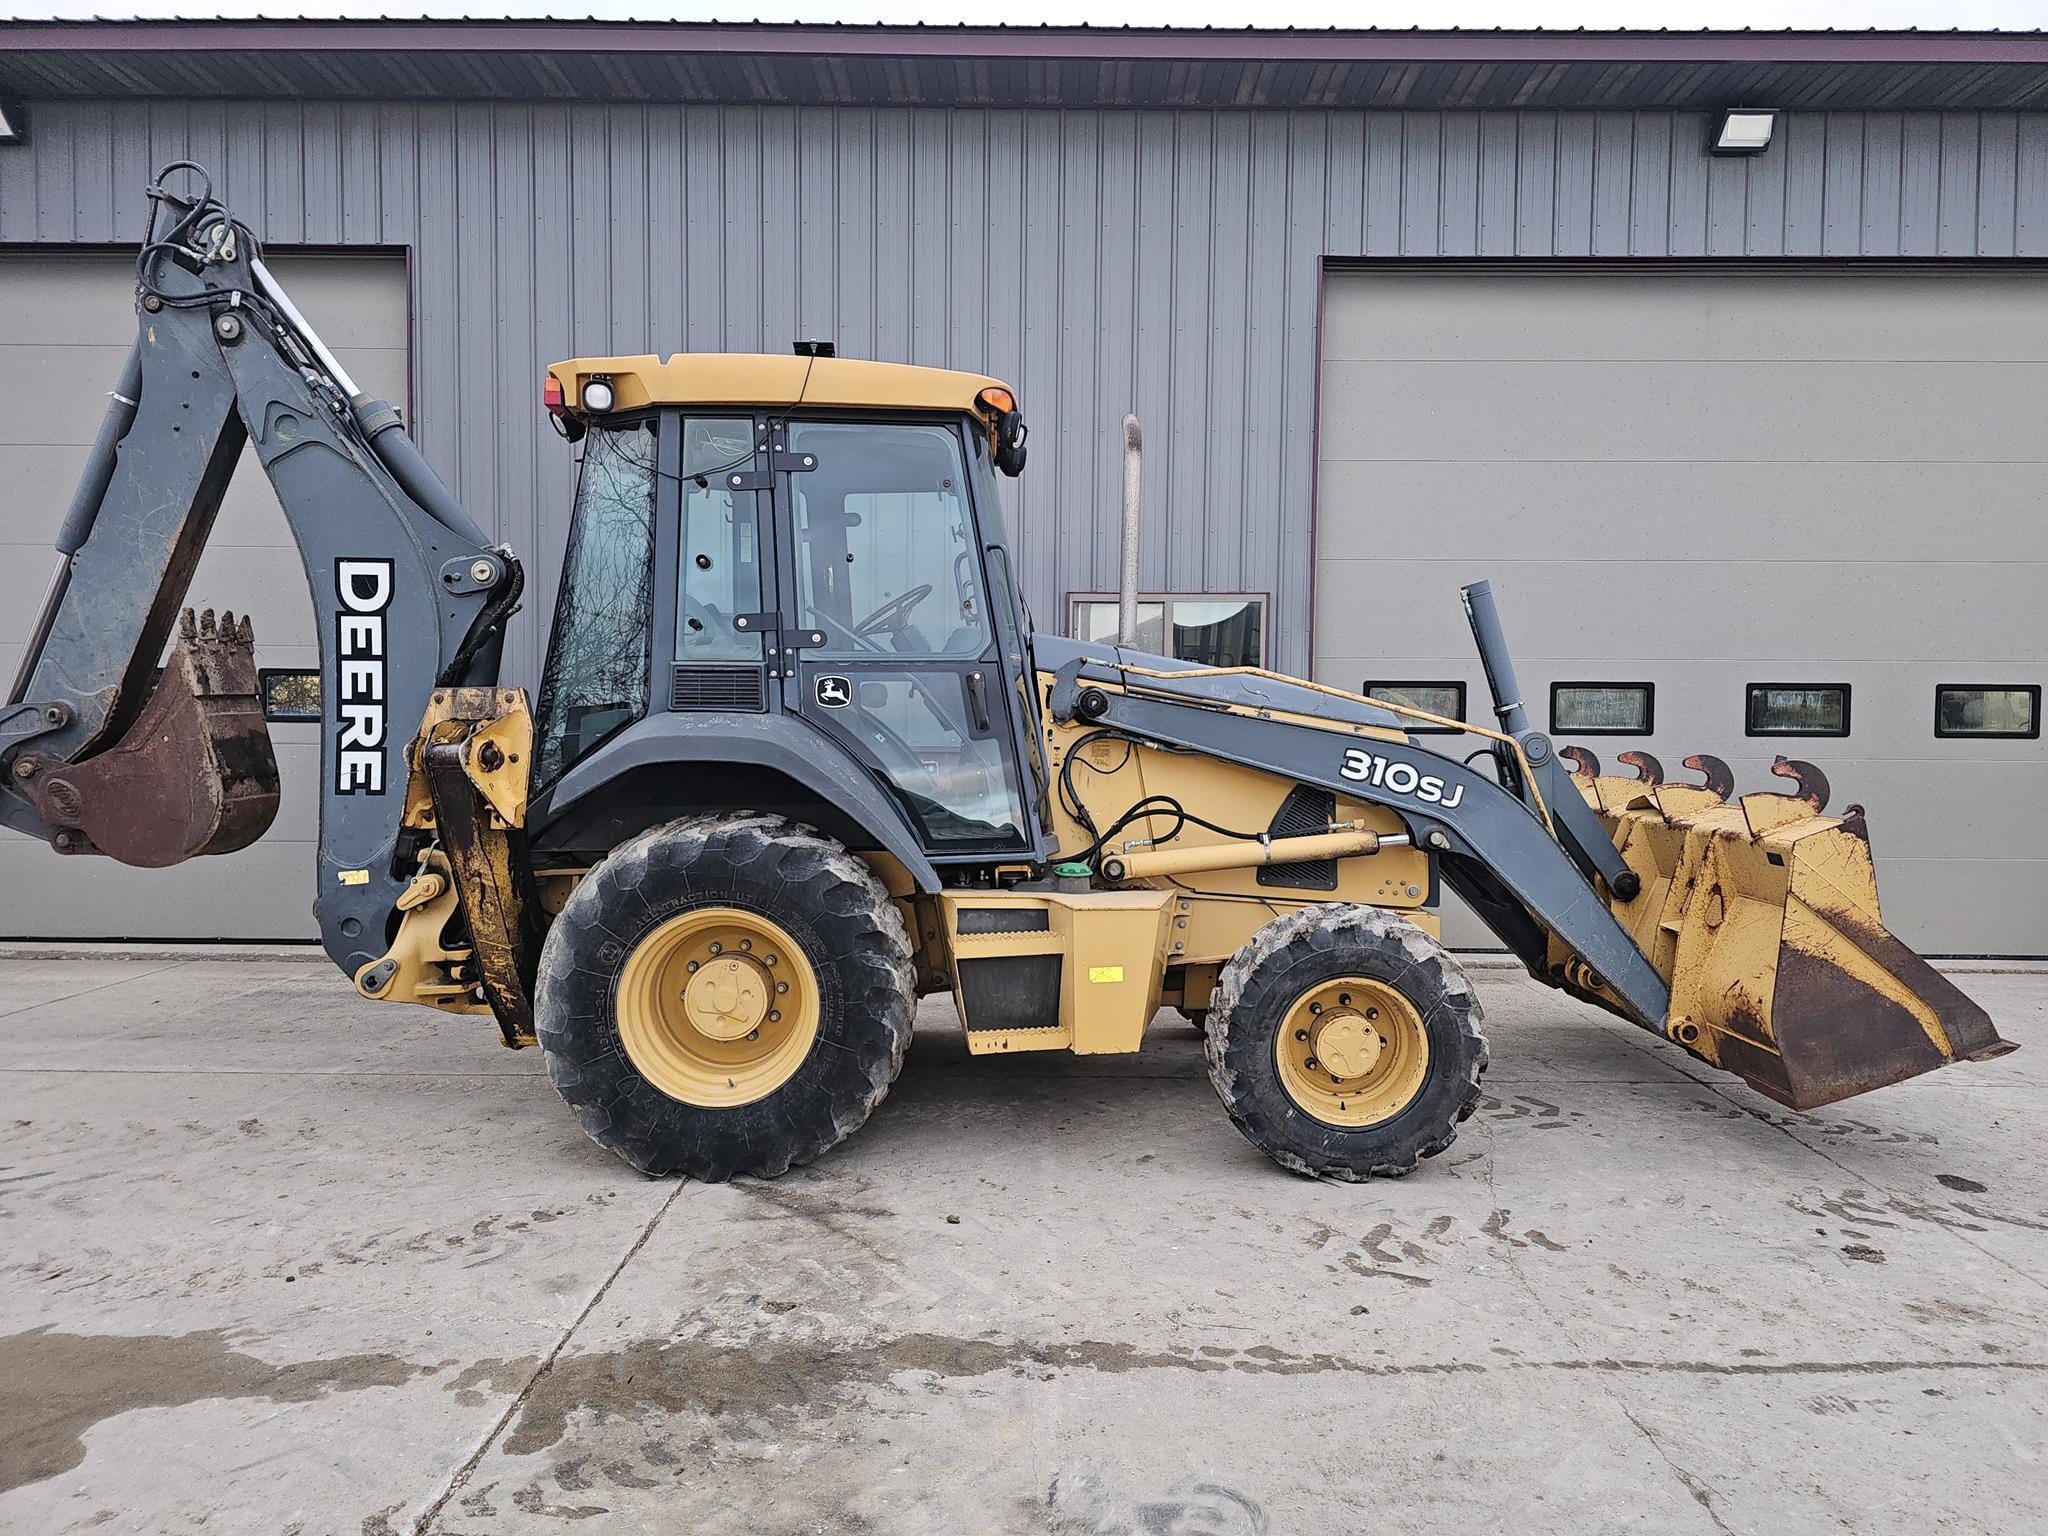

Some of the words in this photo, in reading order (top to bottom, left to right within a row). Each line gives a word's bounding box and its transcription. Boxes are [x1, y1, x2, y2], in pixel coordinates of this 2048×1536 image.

[337, 560, 392, 793] DEERE
[1340, 749, 1465, 808] 310SJ
[659, 889, 728, 912] TRACTION
